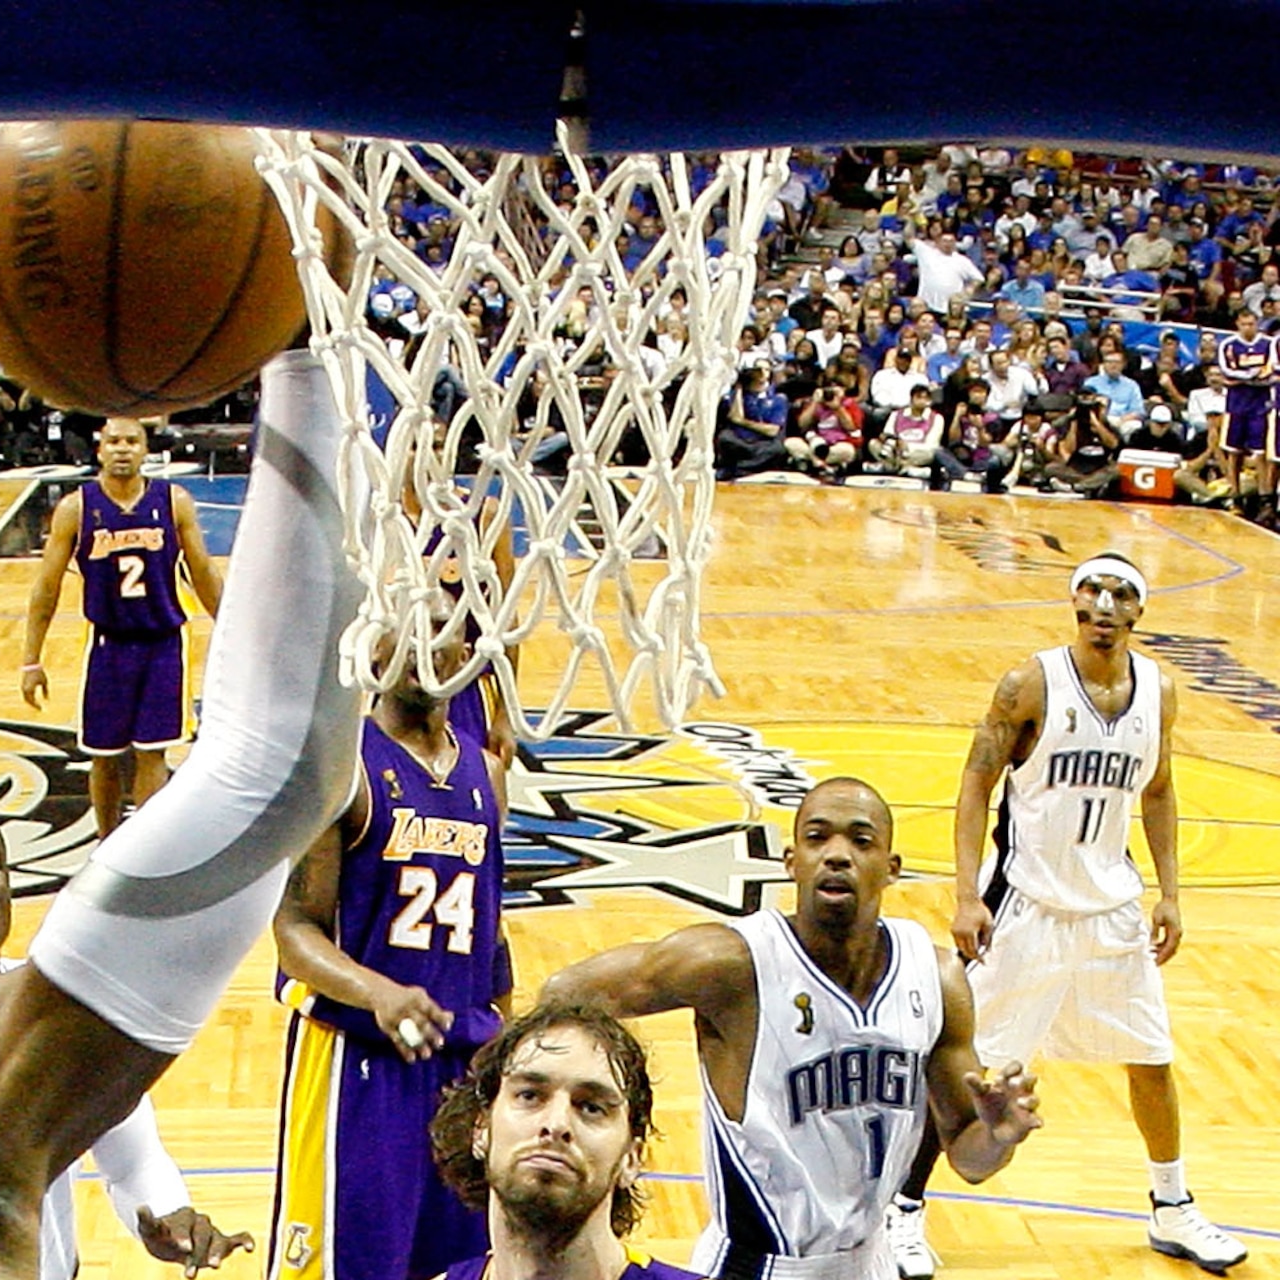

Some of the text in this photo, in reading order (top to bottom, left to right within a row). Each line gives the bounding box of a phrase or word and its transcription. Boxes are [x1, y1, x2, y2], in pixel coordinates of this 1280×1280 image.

[1133, 467, 1156, 490] G
[118, 555, 146, 598] 2
[1046, 749, 1142, 793] MAGIC
[382, 807, 488, 866] LAKERS
[1077, 797, 1107, 844] 11
[388, 866, 476, 955] 24
[786, 1045, 919, 1128] MAGI
[863, 1112, 886, 1181] 1
